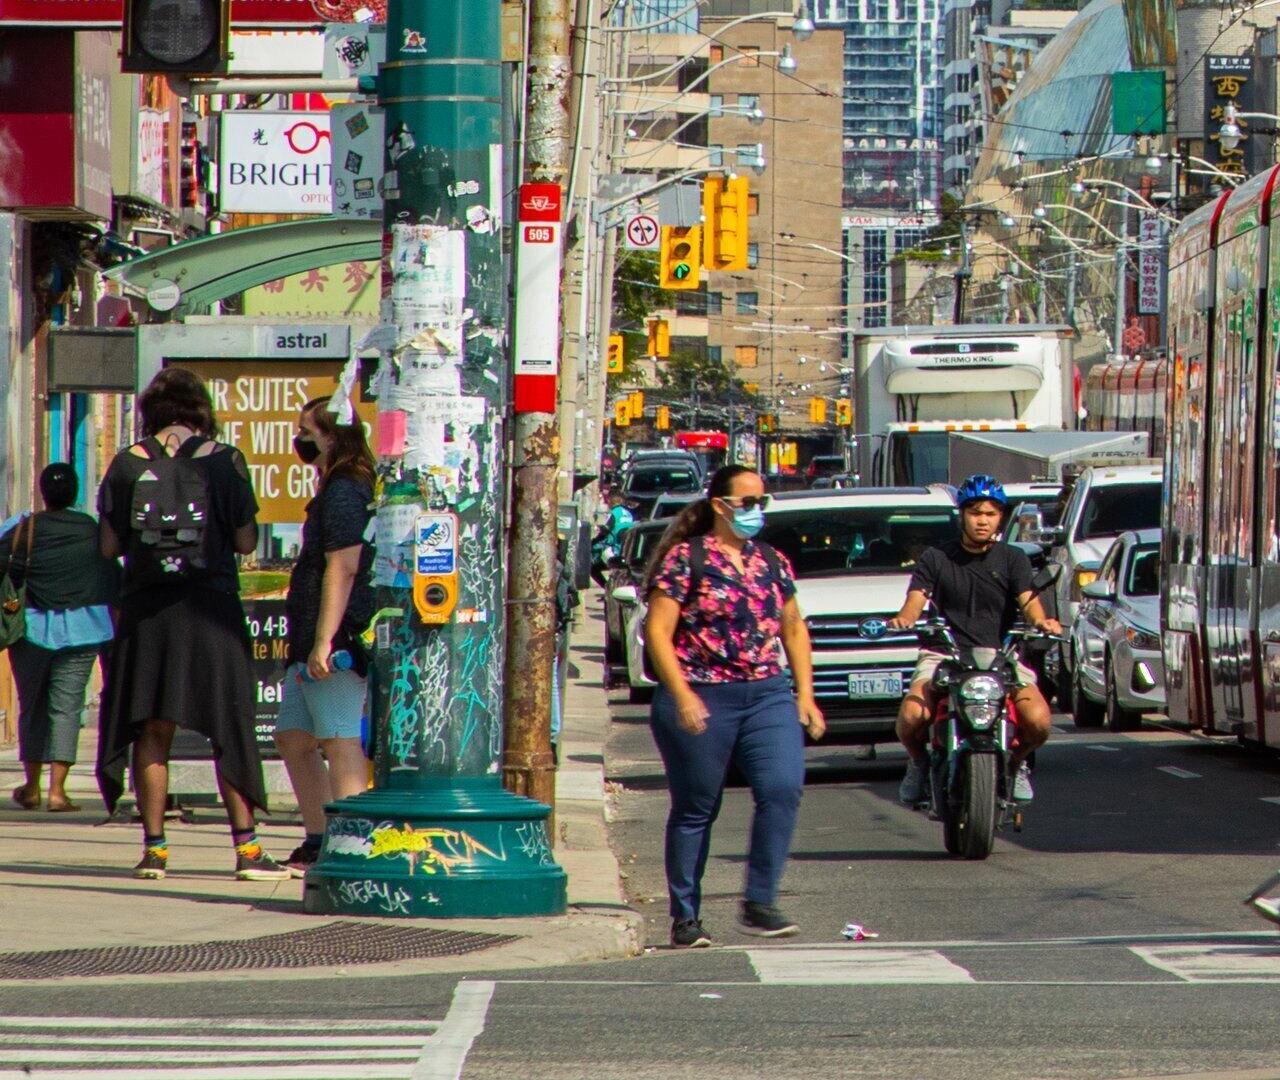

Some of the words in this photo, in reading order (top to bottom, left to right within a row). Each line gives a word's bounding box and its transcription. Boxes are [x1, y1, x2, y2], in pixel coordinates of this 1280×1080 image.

[529, 228, 550, 241] 505
[276, 333, 327, 349] astral
[934, 356, 971, 364] THERMO
[972, 355, 994, 363] KING
[236, 378, 309, 411] SUITES
[882, 679, 900, 692] 709
